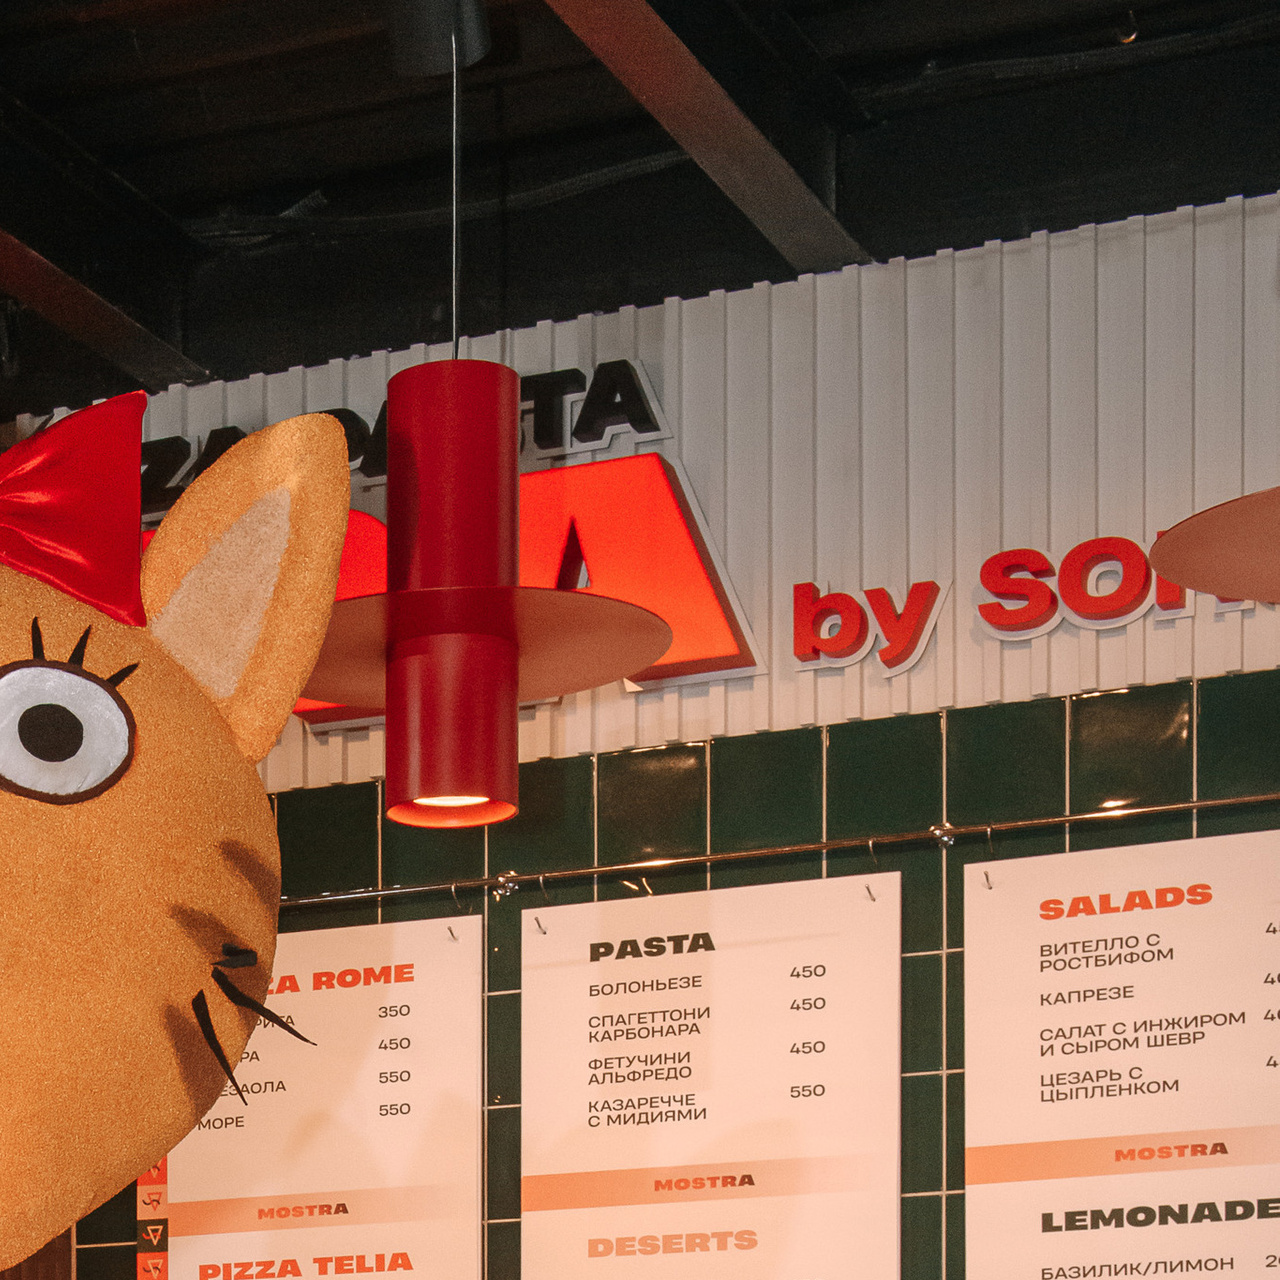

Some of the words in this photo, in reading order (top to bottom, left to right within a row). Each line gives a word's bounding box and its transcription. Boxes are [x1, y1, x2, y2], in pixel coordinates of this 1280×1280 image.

[793, 580, 940, 669] by
[1039, 883, 1213, 921] SALADS
[589, 932, 716, 962] PASTA
[1040, 935, 1140, 958] ВИТЕЛЛО
[1146, 933, 1161, 947] С
[1040, 948, 1174, 973] РОСТБИФОМ
[312, 963, 414, 991] ROME
[789, 964, 827, 979] 450
[589, 975, 703, 998] БОЛОНЬЕЗЕ
[1040, 985, 1134, 1007] КАПРЕЗЕ
[378, 1004, 411, 1018] 350
[789, 997, 827, 1012] 450
[588, 1006, 711, 1029] СПАГЕТТОНИ
[1040, 1021, 1107, 1042] САЛАТ
[1112, 1020, 1127, 1035] С
[1133, 1011, 1246, 1033] ИНЖИРОМ
[378, 1037, 411, 1051] 450
[588, 1023, 702, 1044] КАРБОНАРА
[1040, 1043, 1054, 1057] И
[1060, 1034, 1140, 1056] СЫРОМ
[1147, 1030, 1206, 1050] ШЕВР
[789, 1040, 826, 1055] 450
[588, 1051, 691, 1072] ФЕТУЧИНИ
[379, 1070, 411, 1084] 550
[587, 1066, 693, 1086] АЛЬФРЕДО
[1040, 1068, 1122, 1089] ЦЕЗАРЬ
[1128, 1067, 1143, 1081] С
[220, 1081, 287, 1097] ЕЗАОЛА
[789, 1084, 826, 1099] 550
[1040, 1079, 1180, 1104] ЦЫПЛЕНКОМ
[379, 1103, 411, 1117] 550
[588, 1093, 696, 1113] КАЗАРЕЧЧЕ
[198, 1116, 245, 1131] МОРЕ
[588, 1115, 600, 1128] С
[606, 1108, 708, 1127] МИДИЯМИ
[1114, 1142, 1229, 1162] MOSTRA
[654, 1174, 756, 1192] MOSTRA
[257, 1203, 349, 1221] MOSTRA
[1041, 1198, 1280, 1233] LEMONADE
[587, 1229, 759, 1259] DESERTS
[312, 1251, 414, 1276] TELIA
[1041, 1257, 1234, 1280] БАЗИЛИК/ЛИМОН
